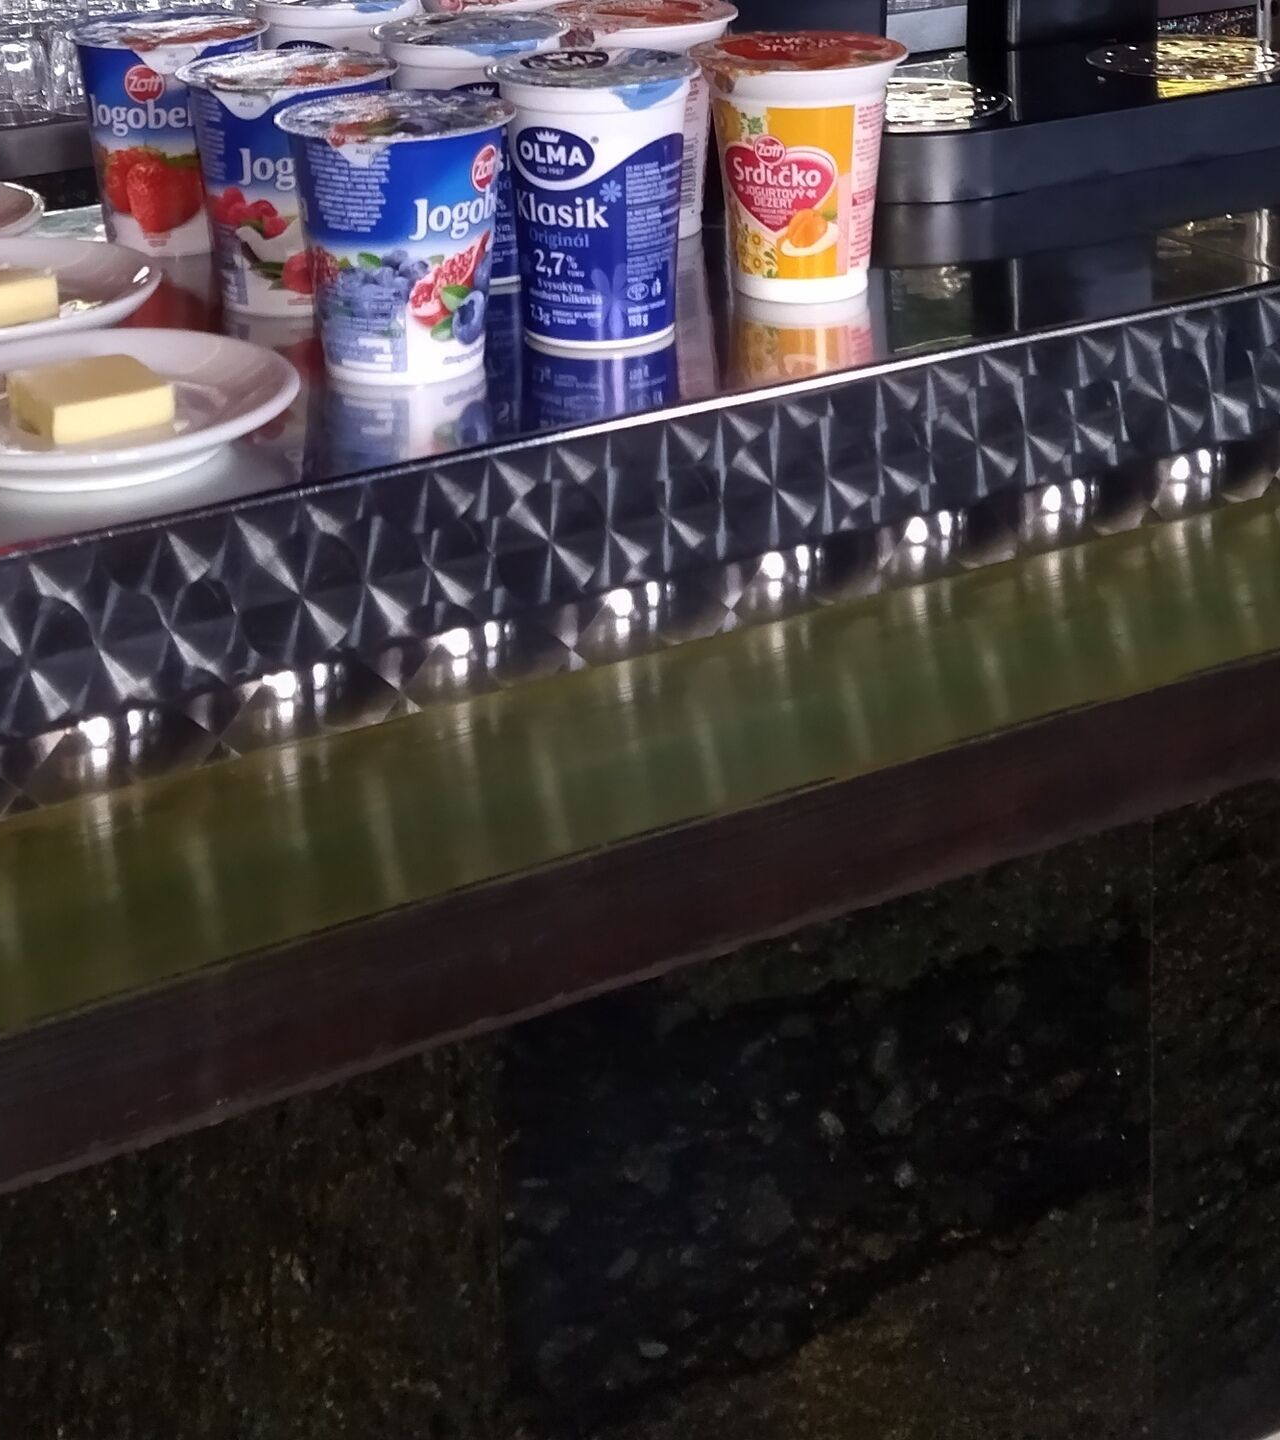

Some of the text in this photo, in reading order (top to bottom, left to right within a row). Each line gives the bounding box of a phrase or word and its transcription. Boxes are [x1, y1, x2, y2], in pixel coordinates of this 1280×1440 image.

[128, 75, 160, 92] Zott
[89, 93, 194, 137] Jogobel
[520, 141, 587, 166] OLMA
[516, 188, 609, 229] Klasik
